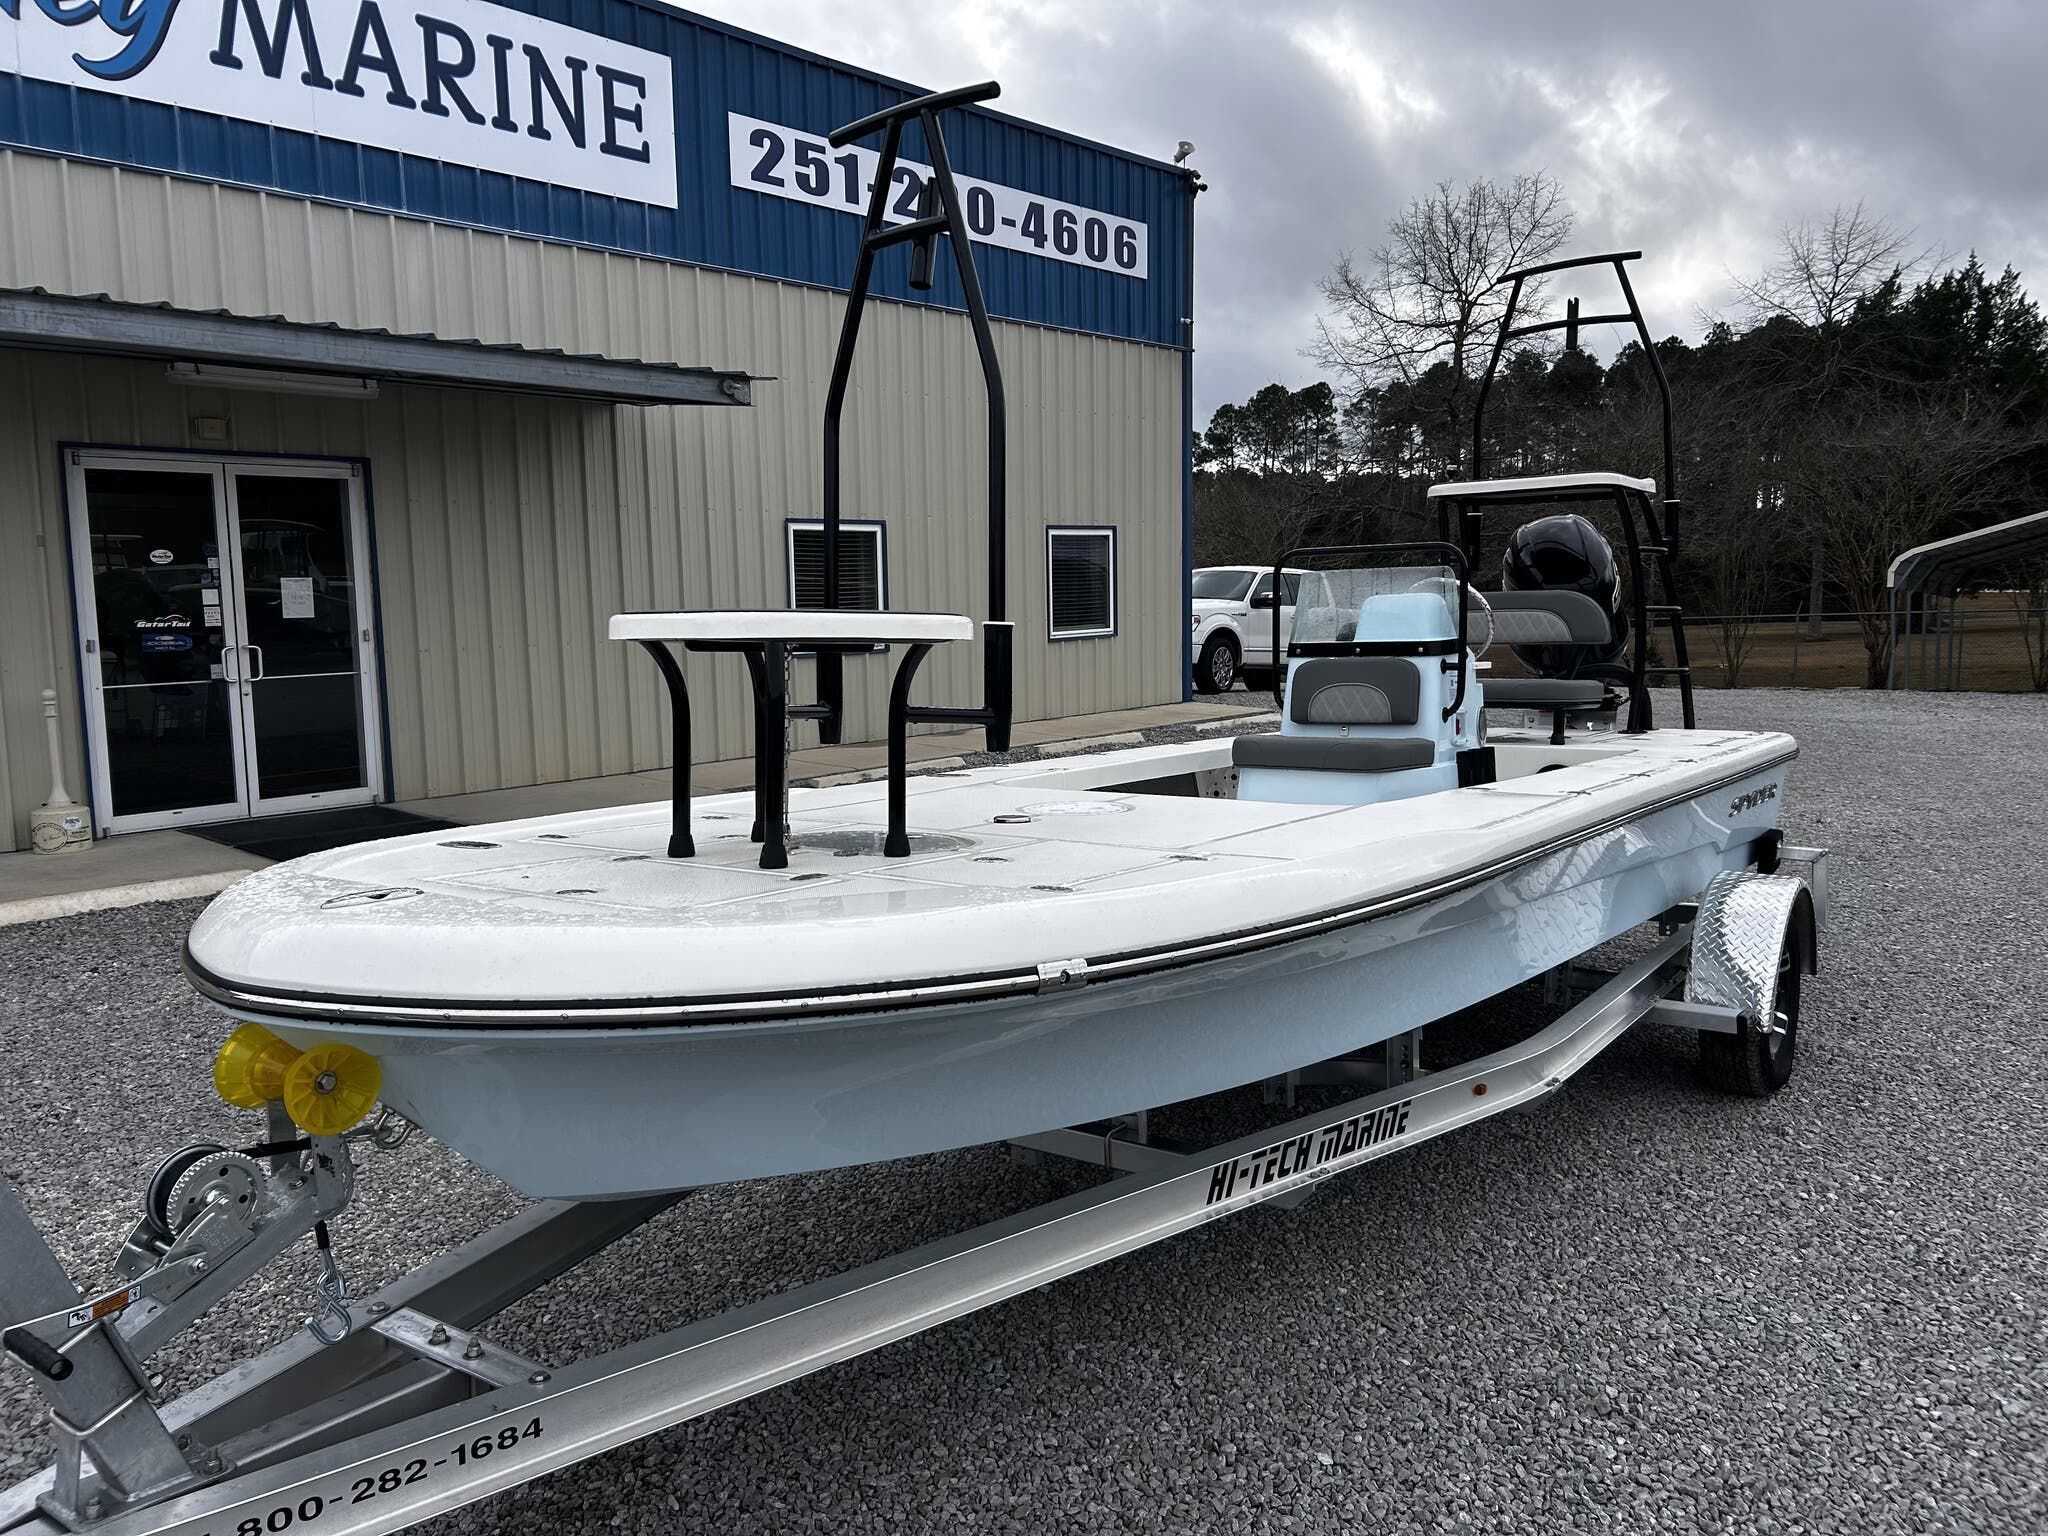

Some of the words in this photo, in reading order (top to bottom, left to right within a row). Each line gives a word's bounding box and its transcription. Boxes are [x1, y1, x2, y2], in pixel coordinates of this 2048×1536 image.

[209, 0, 651, 164] MARINE
[749, 128, 1138, 269] 25120-4606
[1206, 1135, 1313, 1205] HI-TECH
[1316, 1100, 1413, 1162] MARINE
